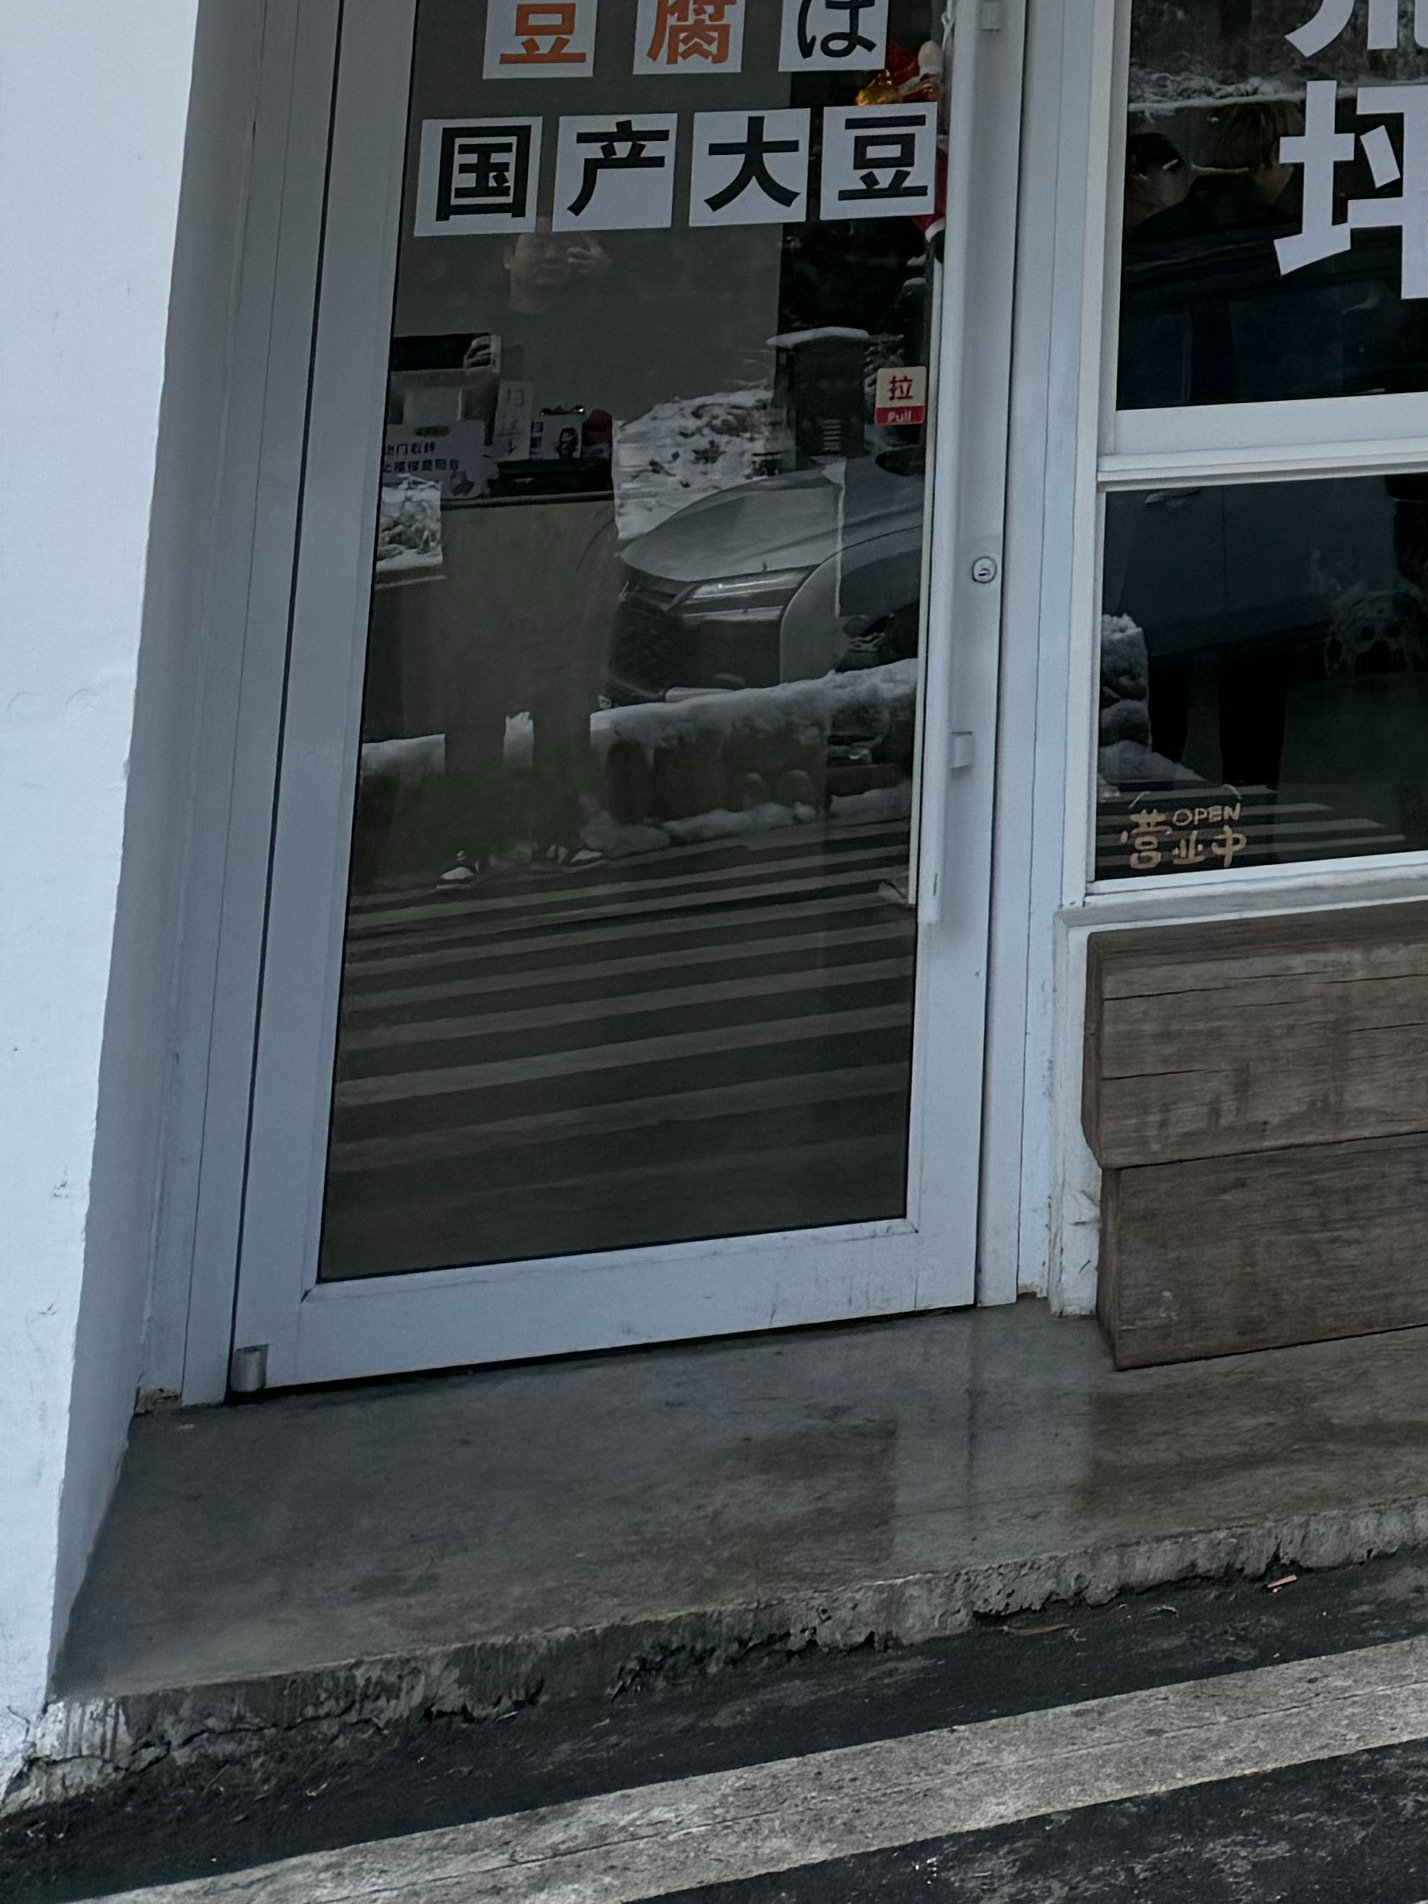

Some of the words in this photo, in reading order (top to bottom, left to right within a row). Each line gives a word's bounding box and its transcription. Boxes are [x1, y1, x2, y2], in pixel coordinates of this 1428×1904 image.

[435, 114, 929, 222] 国产大豆
[887, 375, 914, 402] 拉
[886, 410, 913, 424] Pull
[1172, 801, 1242, 827] OPEN
